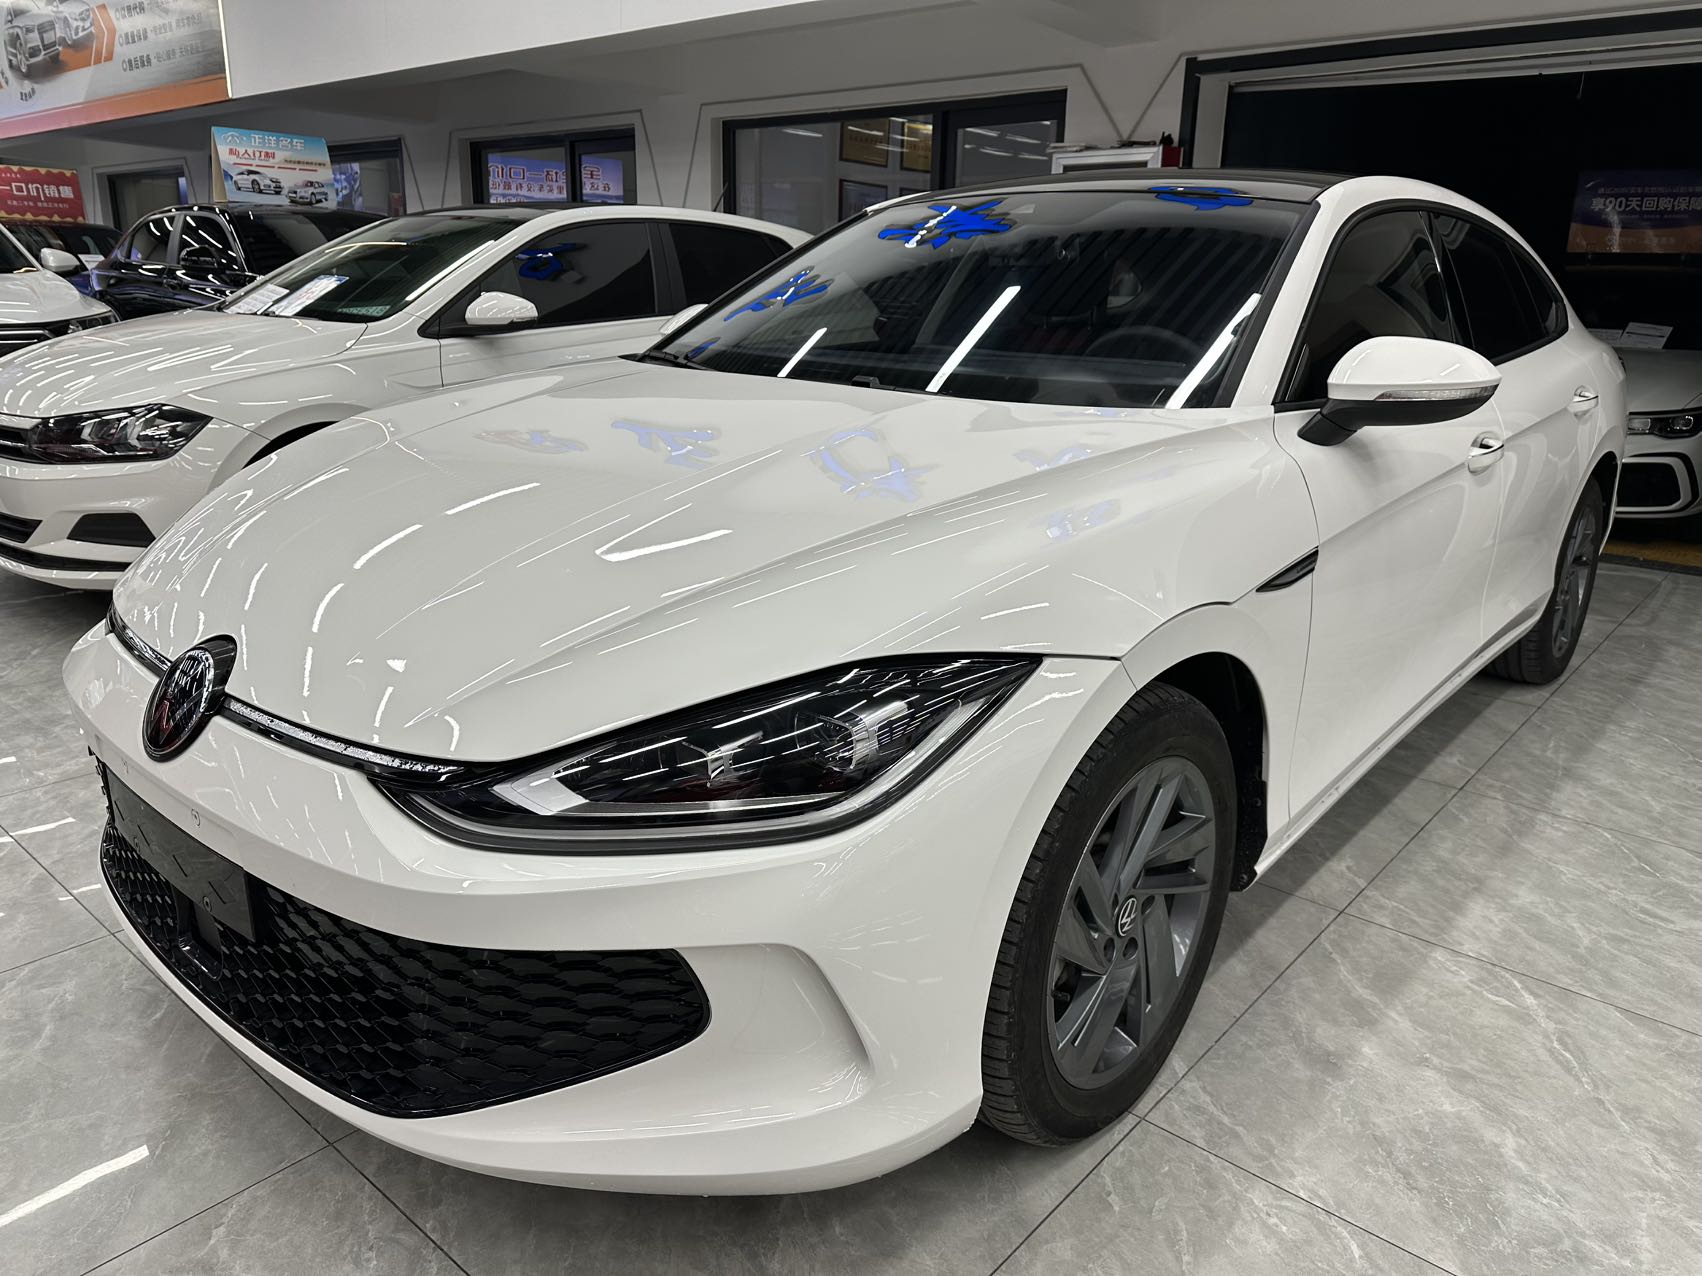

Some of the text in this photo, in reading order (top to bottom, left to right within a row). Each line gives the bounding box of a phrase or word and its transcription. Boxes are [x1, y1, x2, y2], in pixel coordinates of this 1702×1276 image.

[251, 134, 305, 150] 正洋名车
[228, 147, 276, 161] 私人订制
